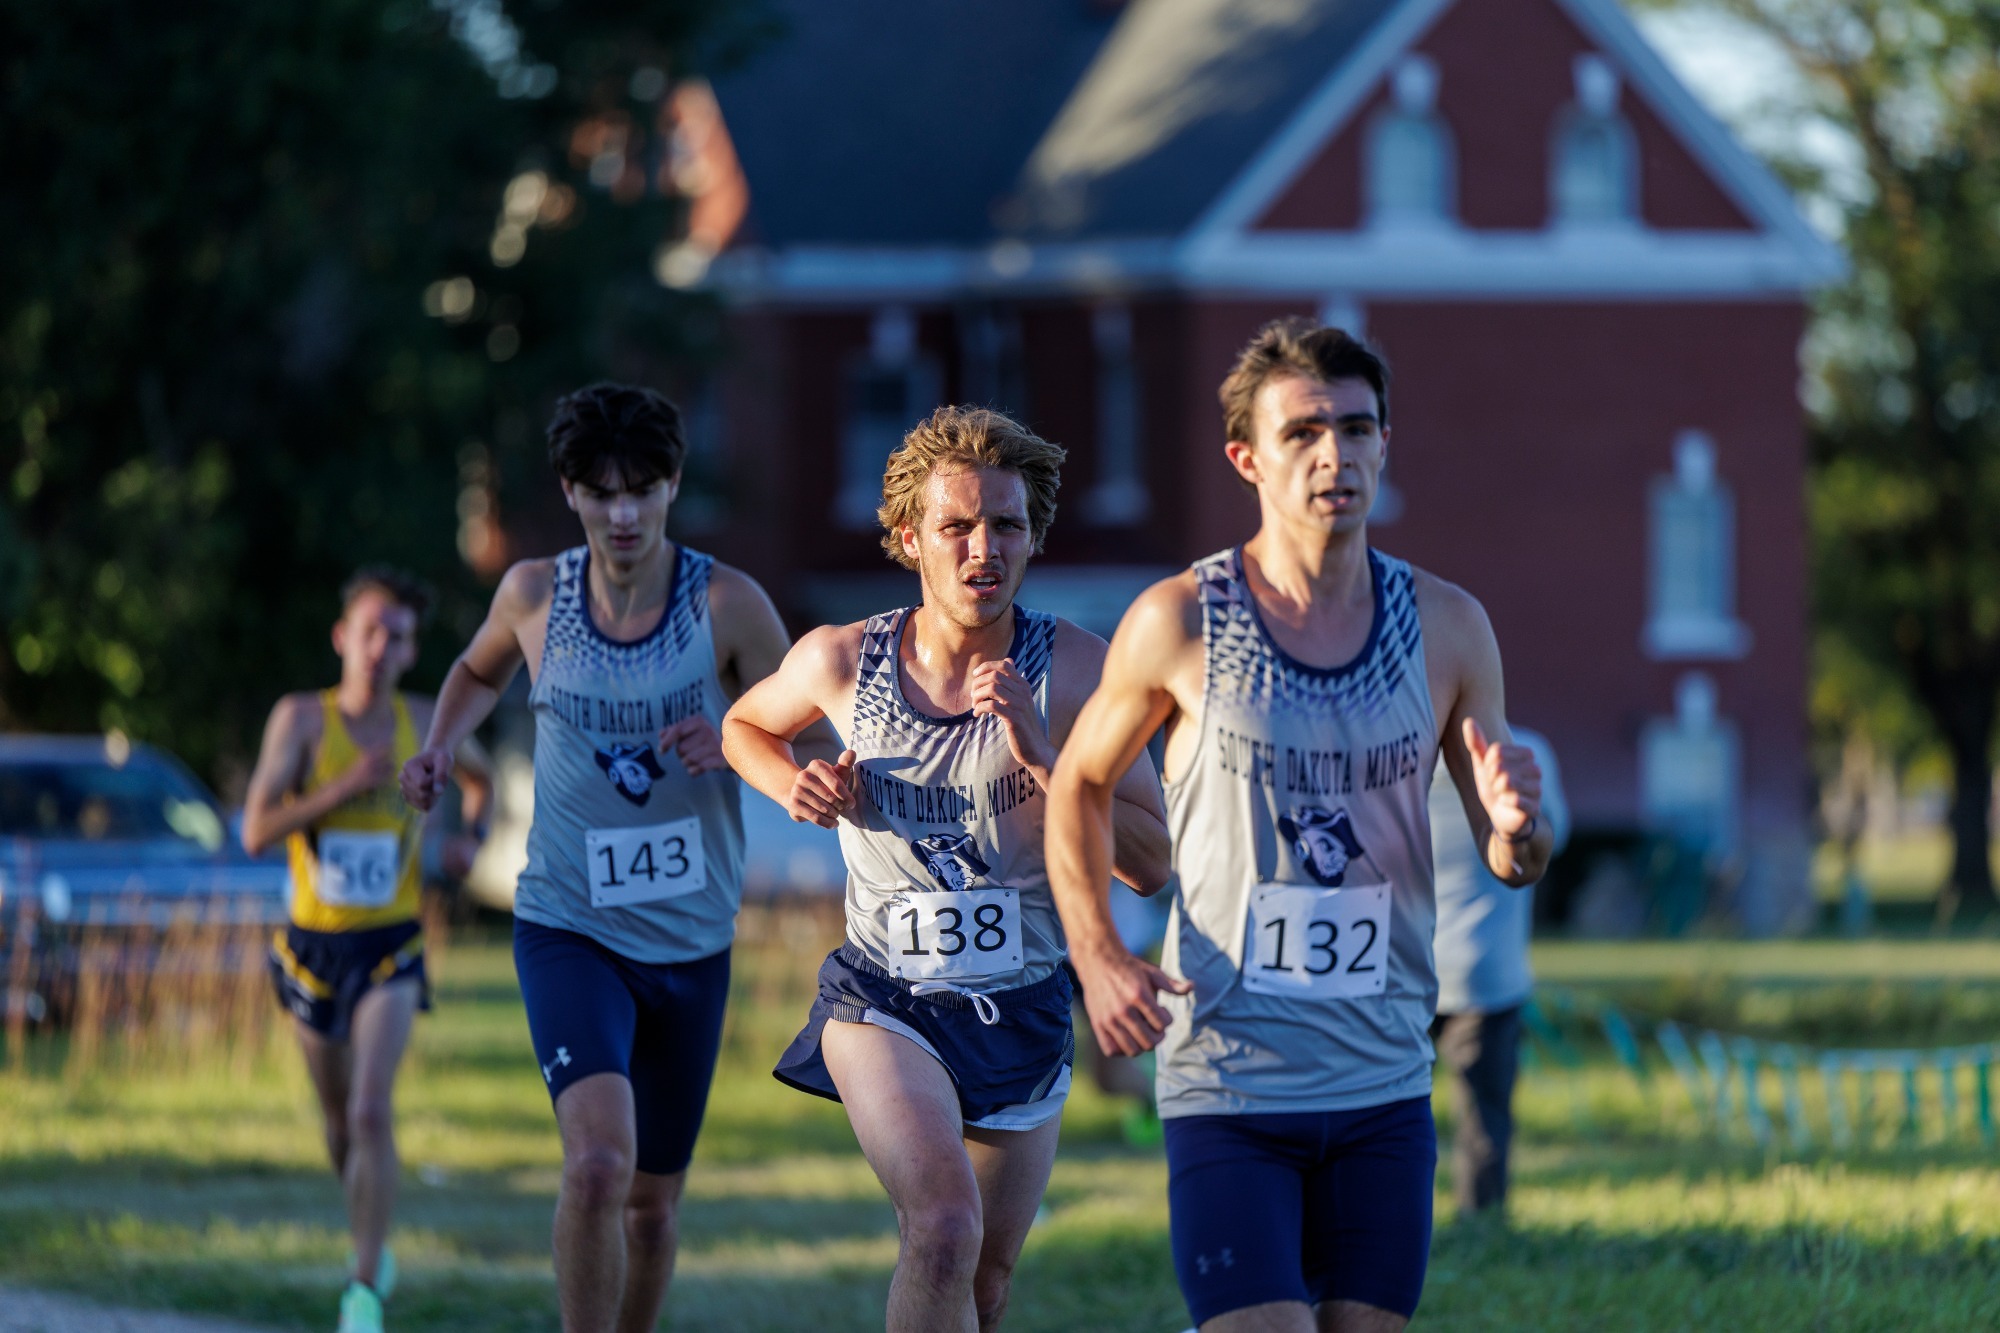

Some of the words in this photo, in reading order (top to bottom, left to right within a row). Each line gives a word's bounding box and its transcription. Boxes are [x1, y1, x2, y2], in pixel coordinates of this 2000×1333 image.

[551, 685, 591, 732] SOUTH
[600, 700, 655, 734] DAKOTA
[662, 678, 704, 728] MINES
[1218, 727, 1276, 788] SOUTH
[1287, 748, 1352, 795] DAKOTA
[1364, 731, 1419, 791] MINES
[859, 764, 907, 819] SOUTH
[914, 784, 978, 823] DAKOTA
[986, 766, 1036, 818] MINES
[597, 836, 690, 888] 143
[900, 904, 1007, 956] 138
[1261, 918, 1377, 975] 132
